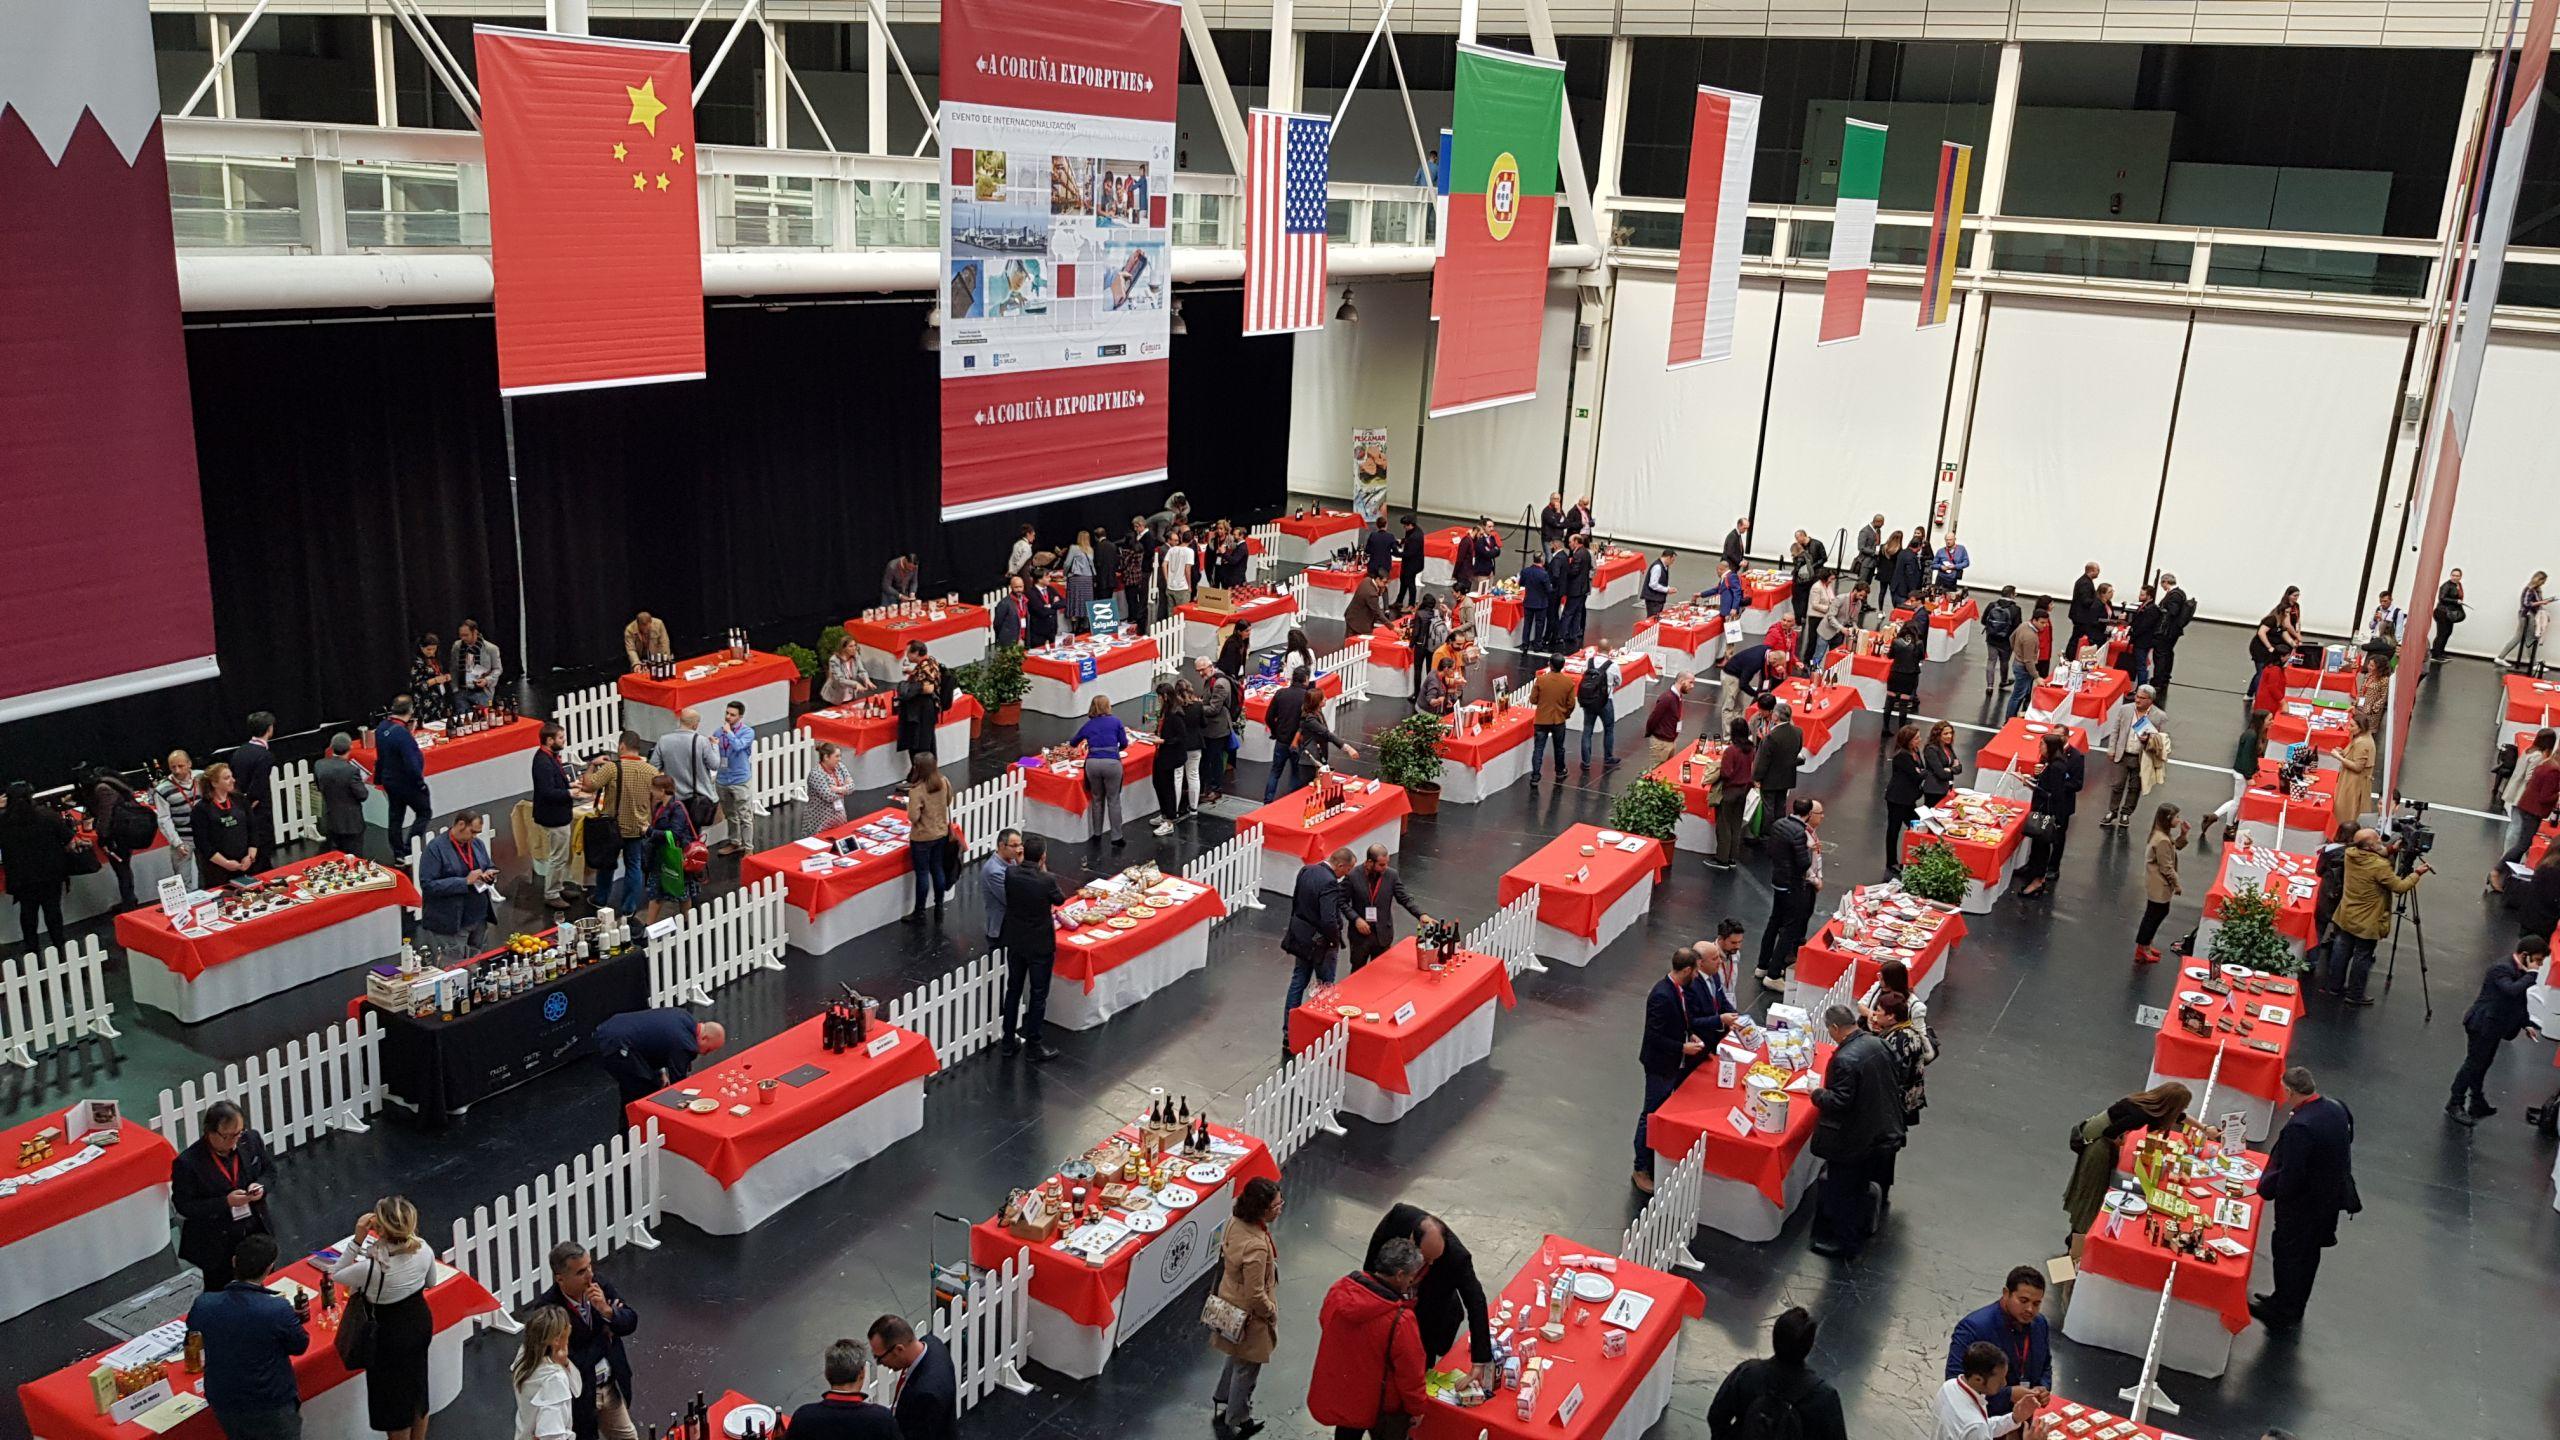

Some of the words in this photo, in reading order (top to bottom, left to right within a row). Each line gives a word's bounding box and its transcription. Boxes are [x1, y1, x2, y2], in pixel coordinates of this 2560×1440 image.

[988, 54, 997, 75] A
[1000, 55, 1057, 82] CORUÑA
[1060, 63, 1144, 92] EXPORPYMES
[951, 112, 980, 123] EVENTO
[982, 115, 992, 124] DE
[993, 116, 1076, 130] INTERNACIONALIZACIÓN
[987, 406, 995, 425] A
[998, 396, 1052, 423] CORUÑA
[1055, 390, 1136, 416] EXPORPYMES
